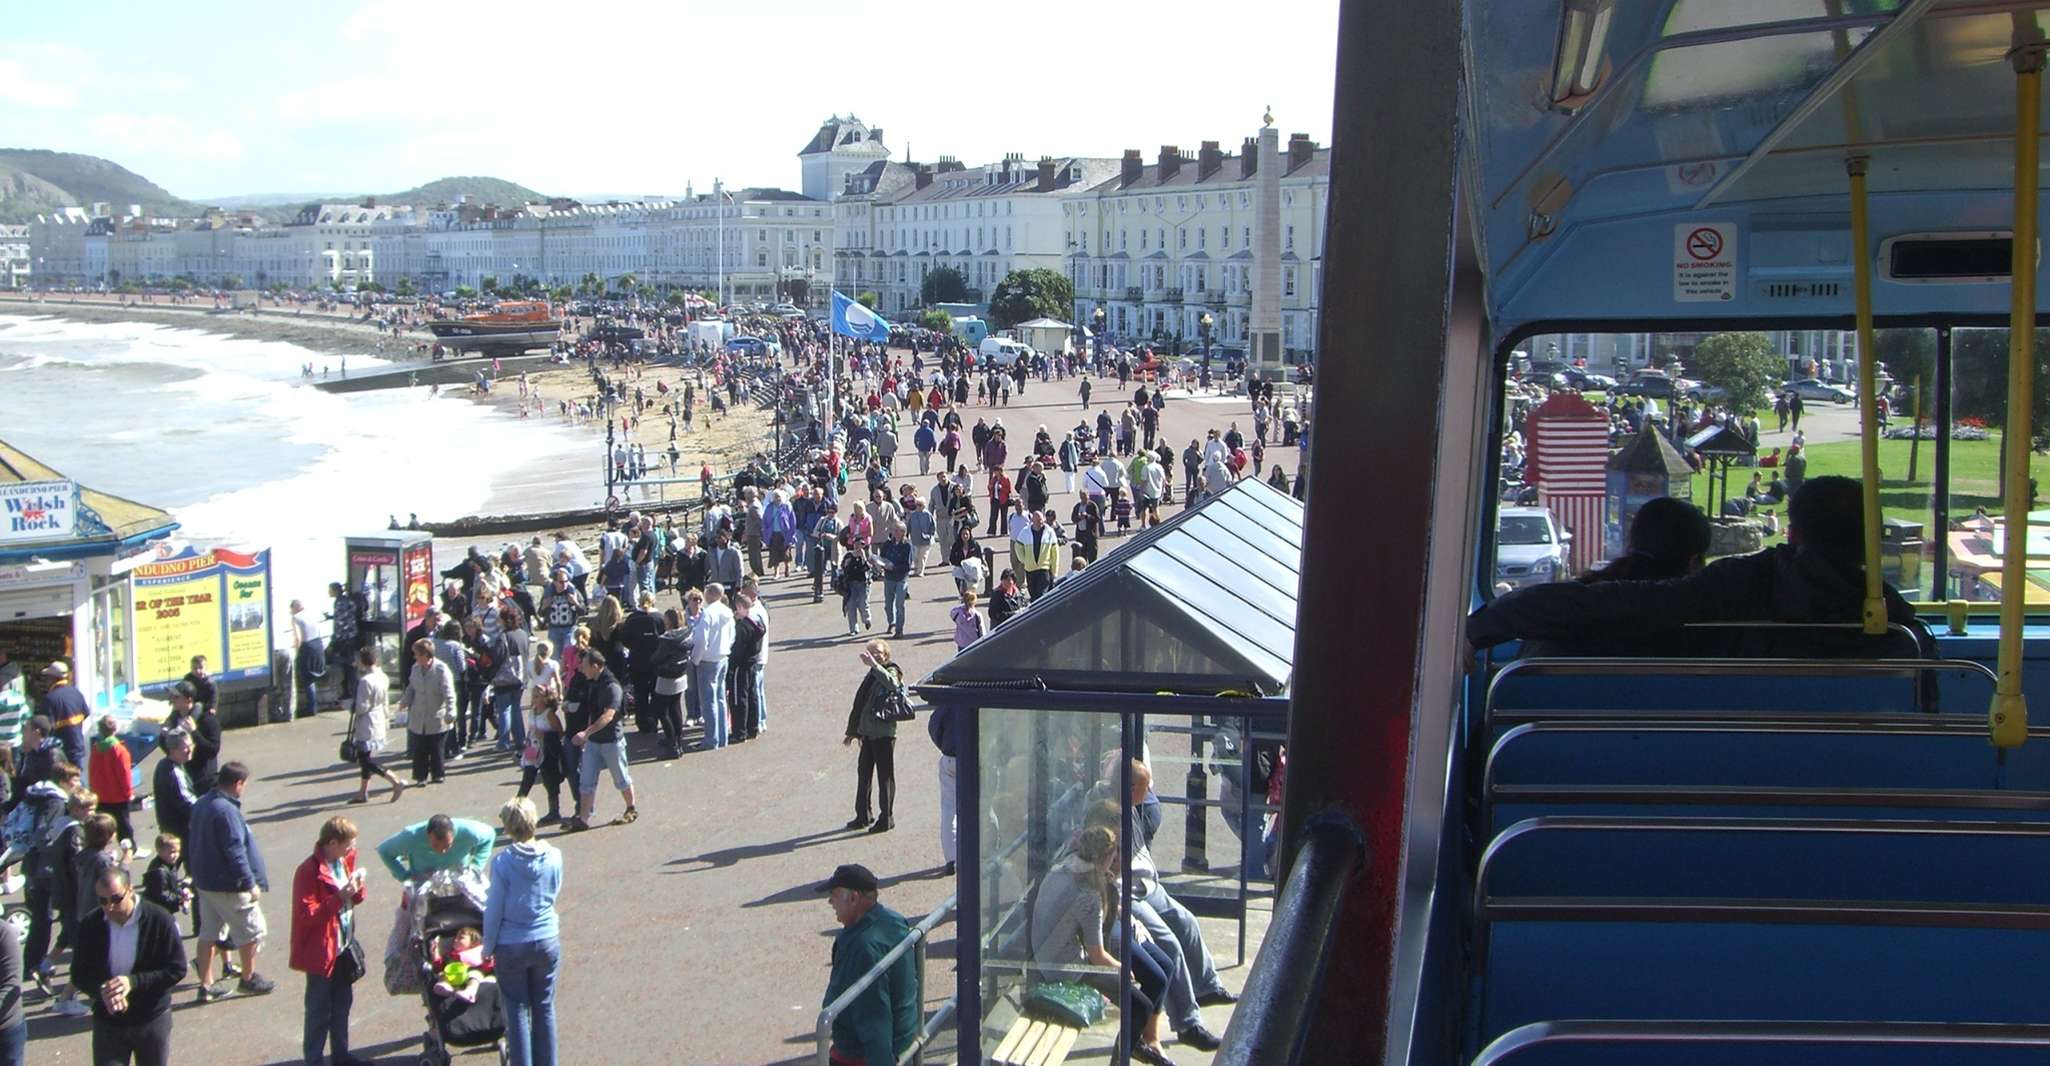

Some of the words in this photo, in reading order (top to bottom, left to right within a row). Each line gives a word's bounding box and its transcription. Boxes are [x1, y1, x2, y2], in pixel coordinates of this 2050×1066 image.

[5, 495, 65, 513] Welsh
[12, 514, 61, 531] Rock
[188, 554, 216, 571] PIER
[149, 599, 163, 609] OF
[164, 596, 185, 608] THE
[186, 593, 213, 605] YEAR
